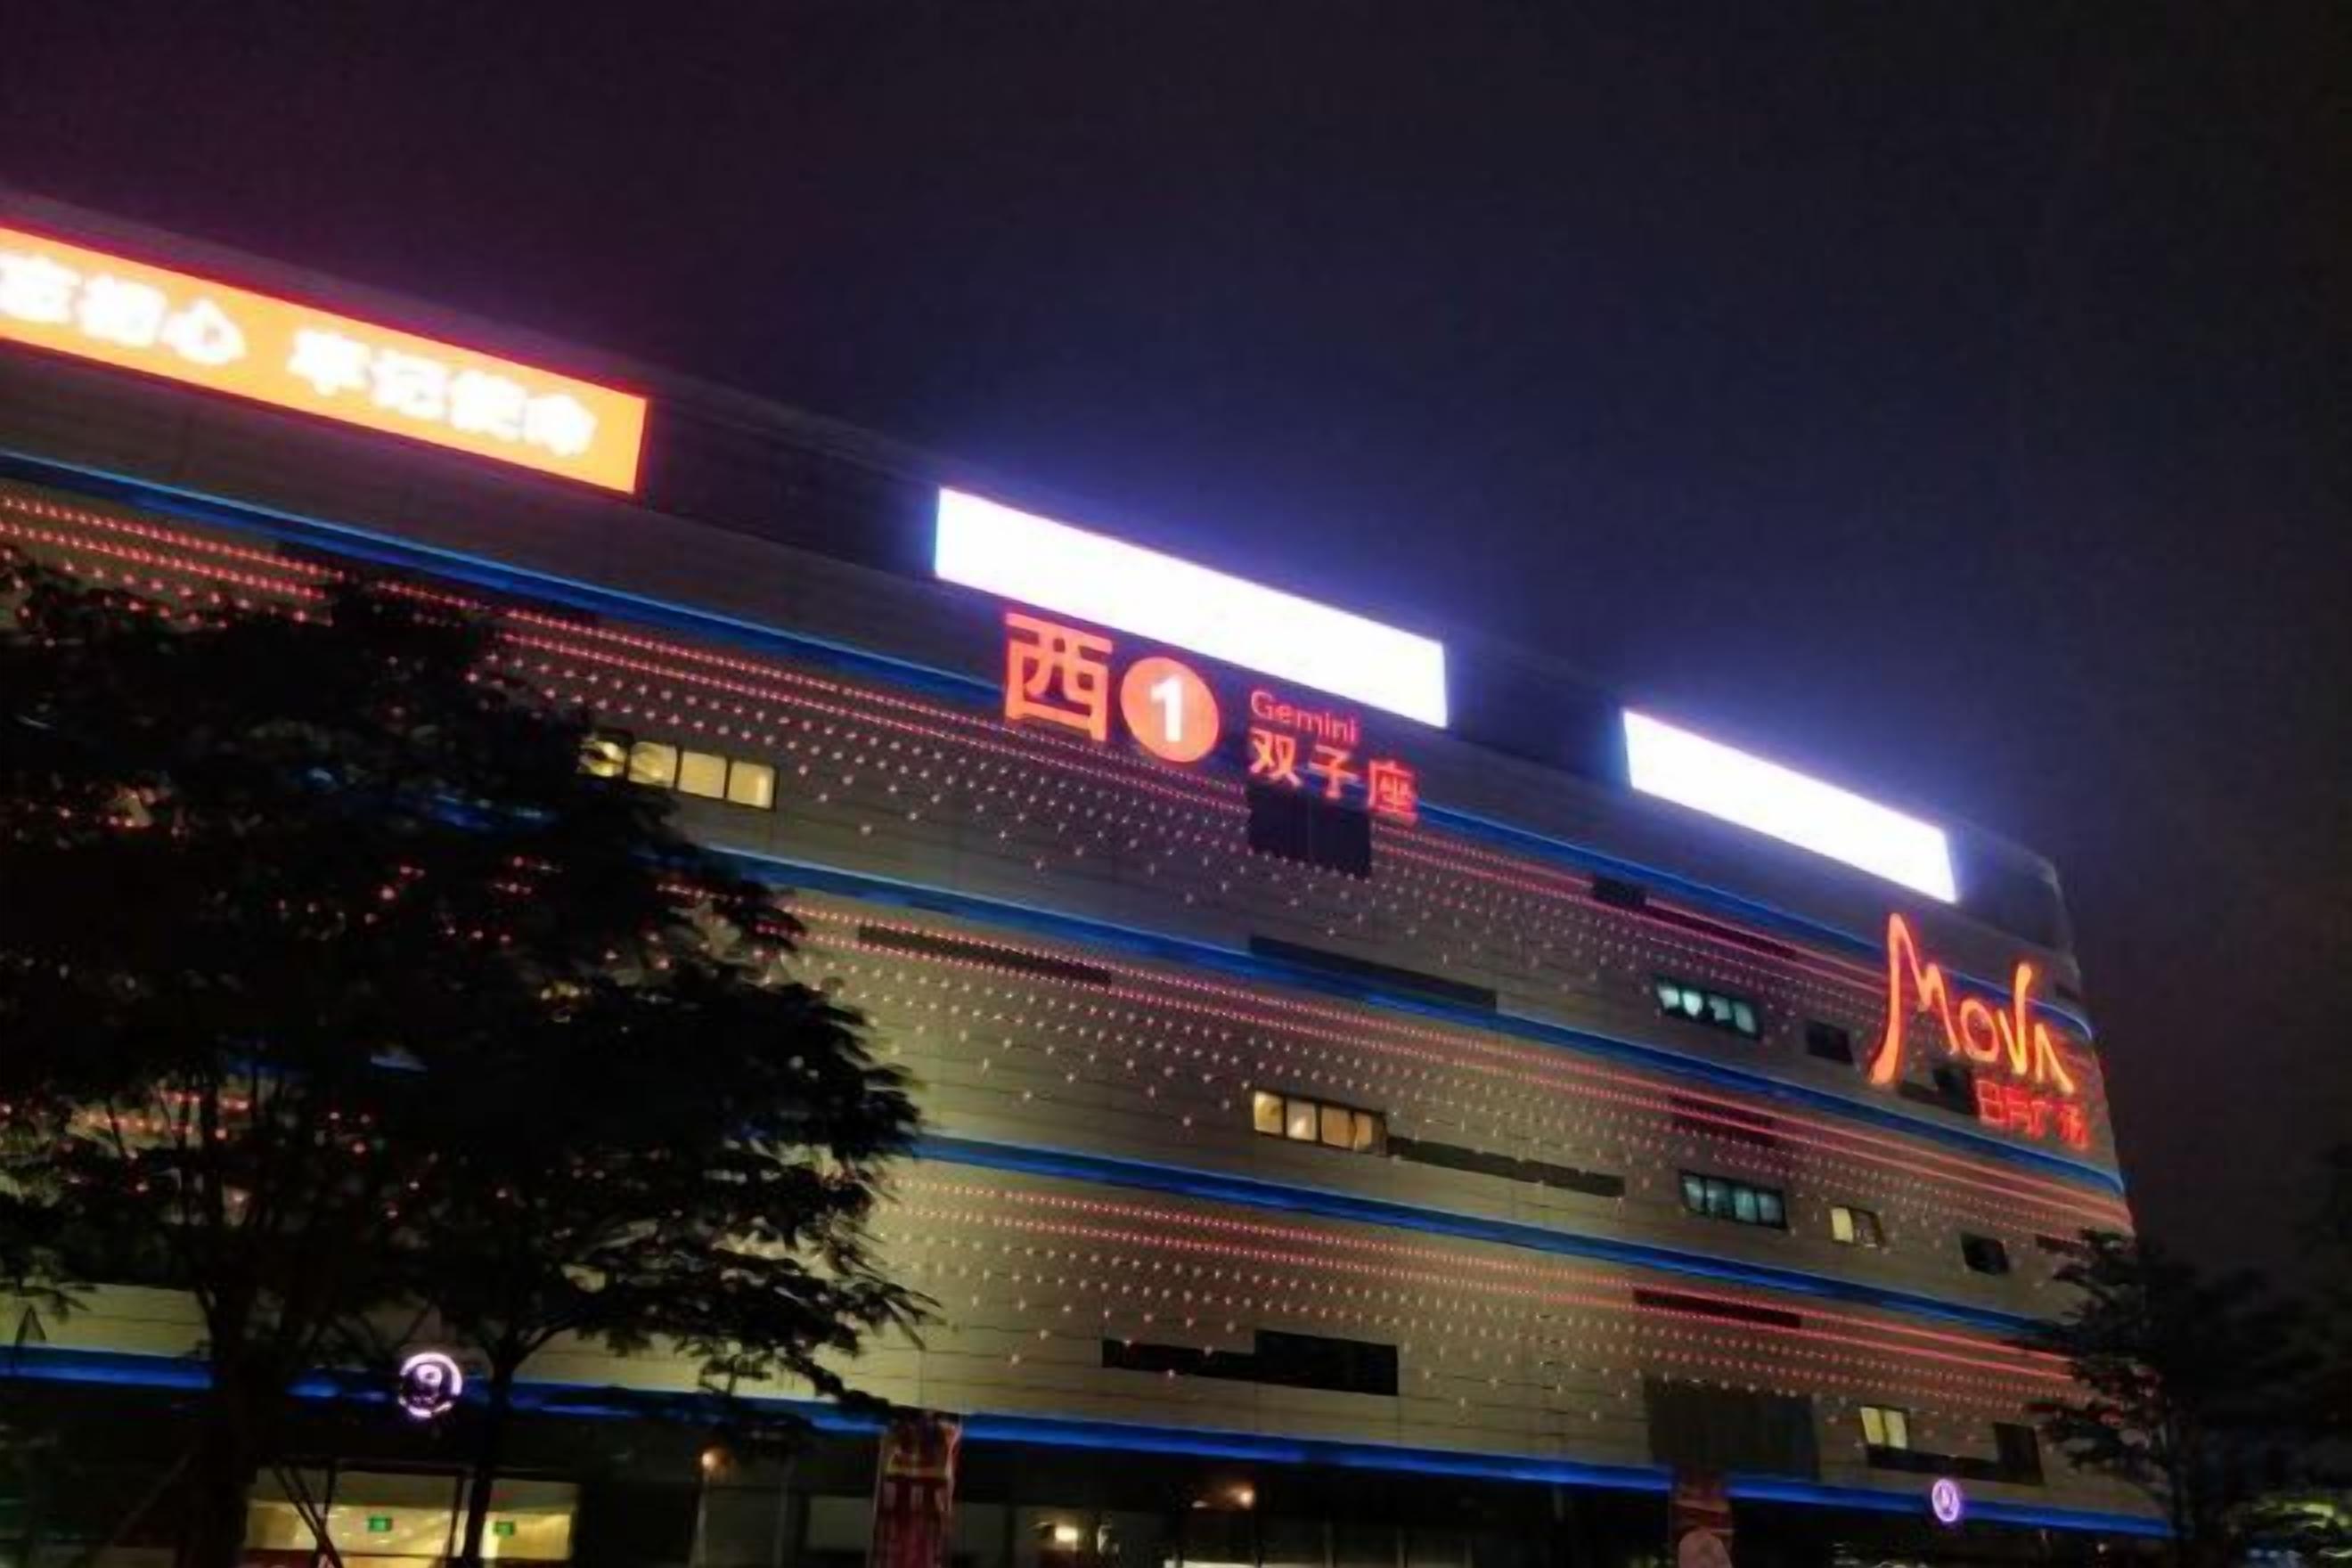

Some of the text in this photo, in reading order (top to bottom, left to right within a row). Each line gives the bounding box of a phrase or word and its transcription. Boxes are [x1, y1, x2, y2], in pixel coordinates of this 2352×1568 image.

[1005, 611, 1113, 741] 西
[1251, 690, 1359, 744] Gemini
[1249, 727, 1418, 824] 双子座
